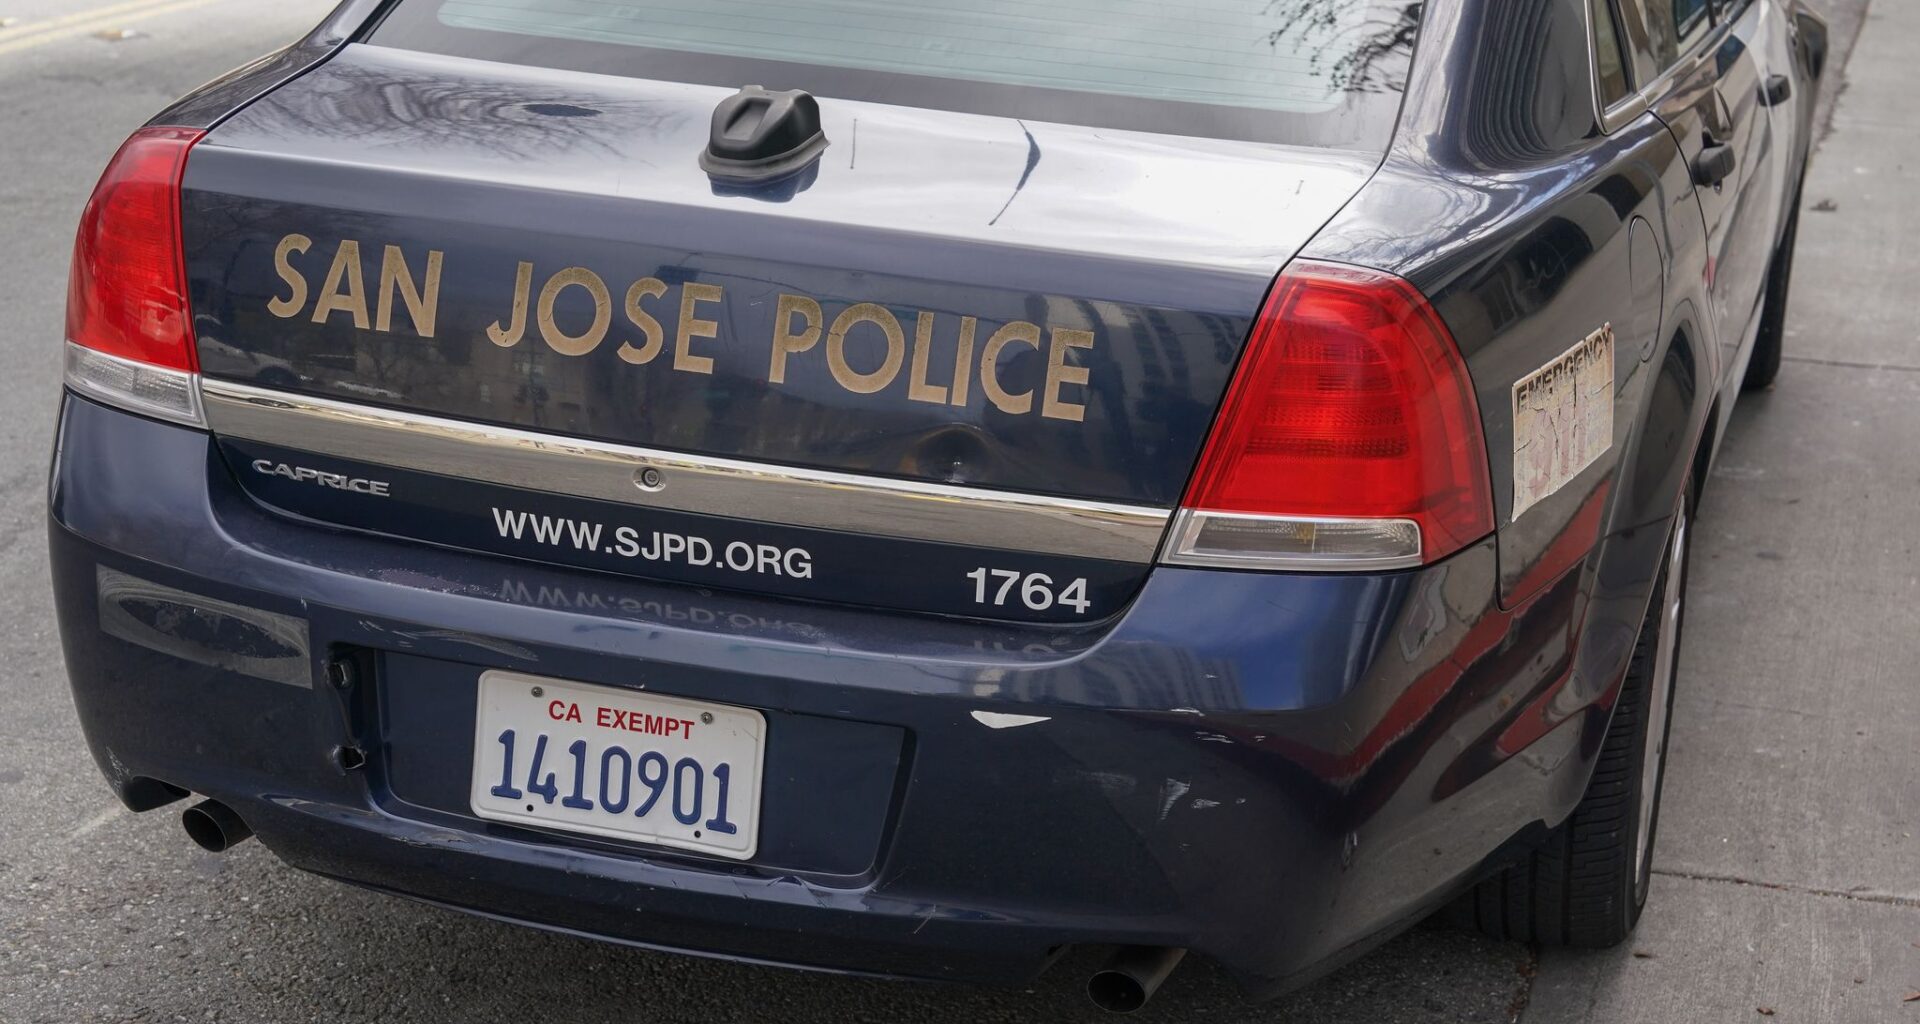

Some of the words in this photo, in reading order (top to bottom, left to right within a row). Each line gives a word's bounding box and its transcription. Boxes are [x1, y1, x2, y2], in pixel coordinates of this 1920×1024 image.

[267, 233, 444, 338] SAN
[486, 261, 723, 375] JOSE
[769, 293, 1095, 422] POLICE
[252, 459, 391, 497] CAPRICE
[492, 507, 812, 579] WWW.SJPD.ORG
[966, 567, 1091, 614] 1764
[549, 700, 582, 723] CA
[597, 707, 695, 740] EXEMPT
[491, 729, 737, 835] 1410901
